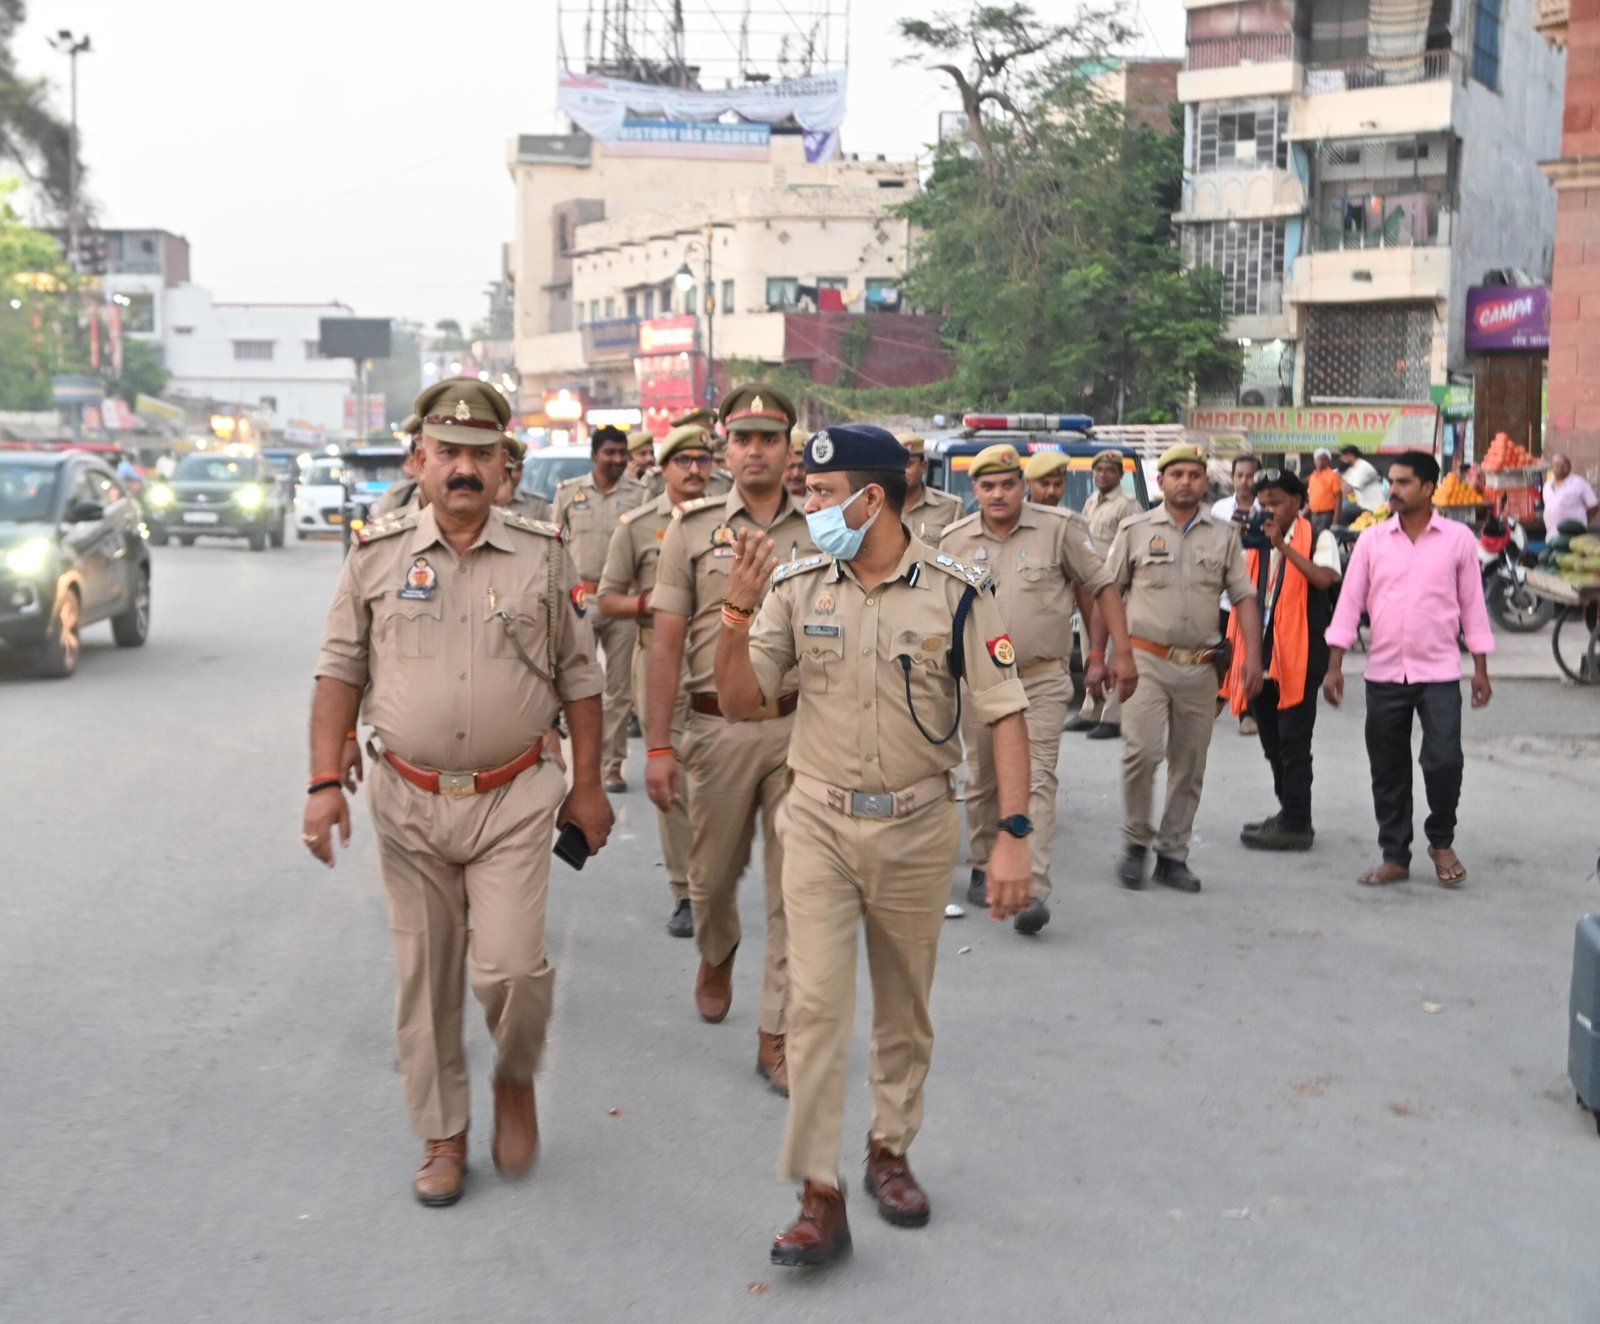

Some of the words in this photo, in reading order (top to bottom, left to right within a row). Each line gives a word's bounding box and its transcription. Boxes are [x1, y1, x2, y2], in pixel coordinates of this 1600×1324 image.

[679, 128, 702, 142] IAS
[704, 129, 769, 145] ACADEMY
[1188, 410, 1291, 432] IMPERIAL
